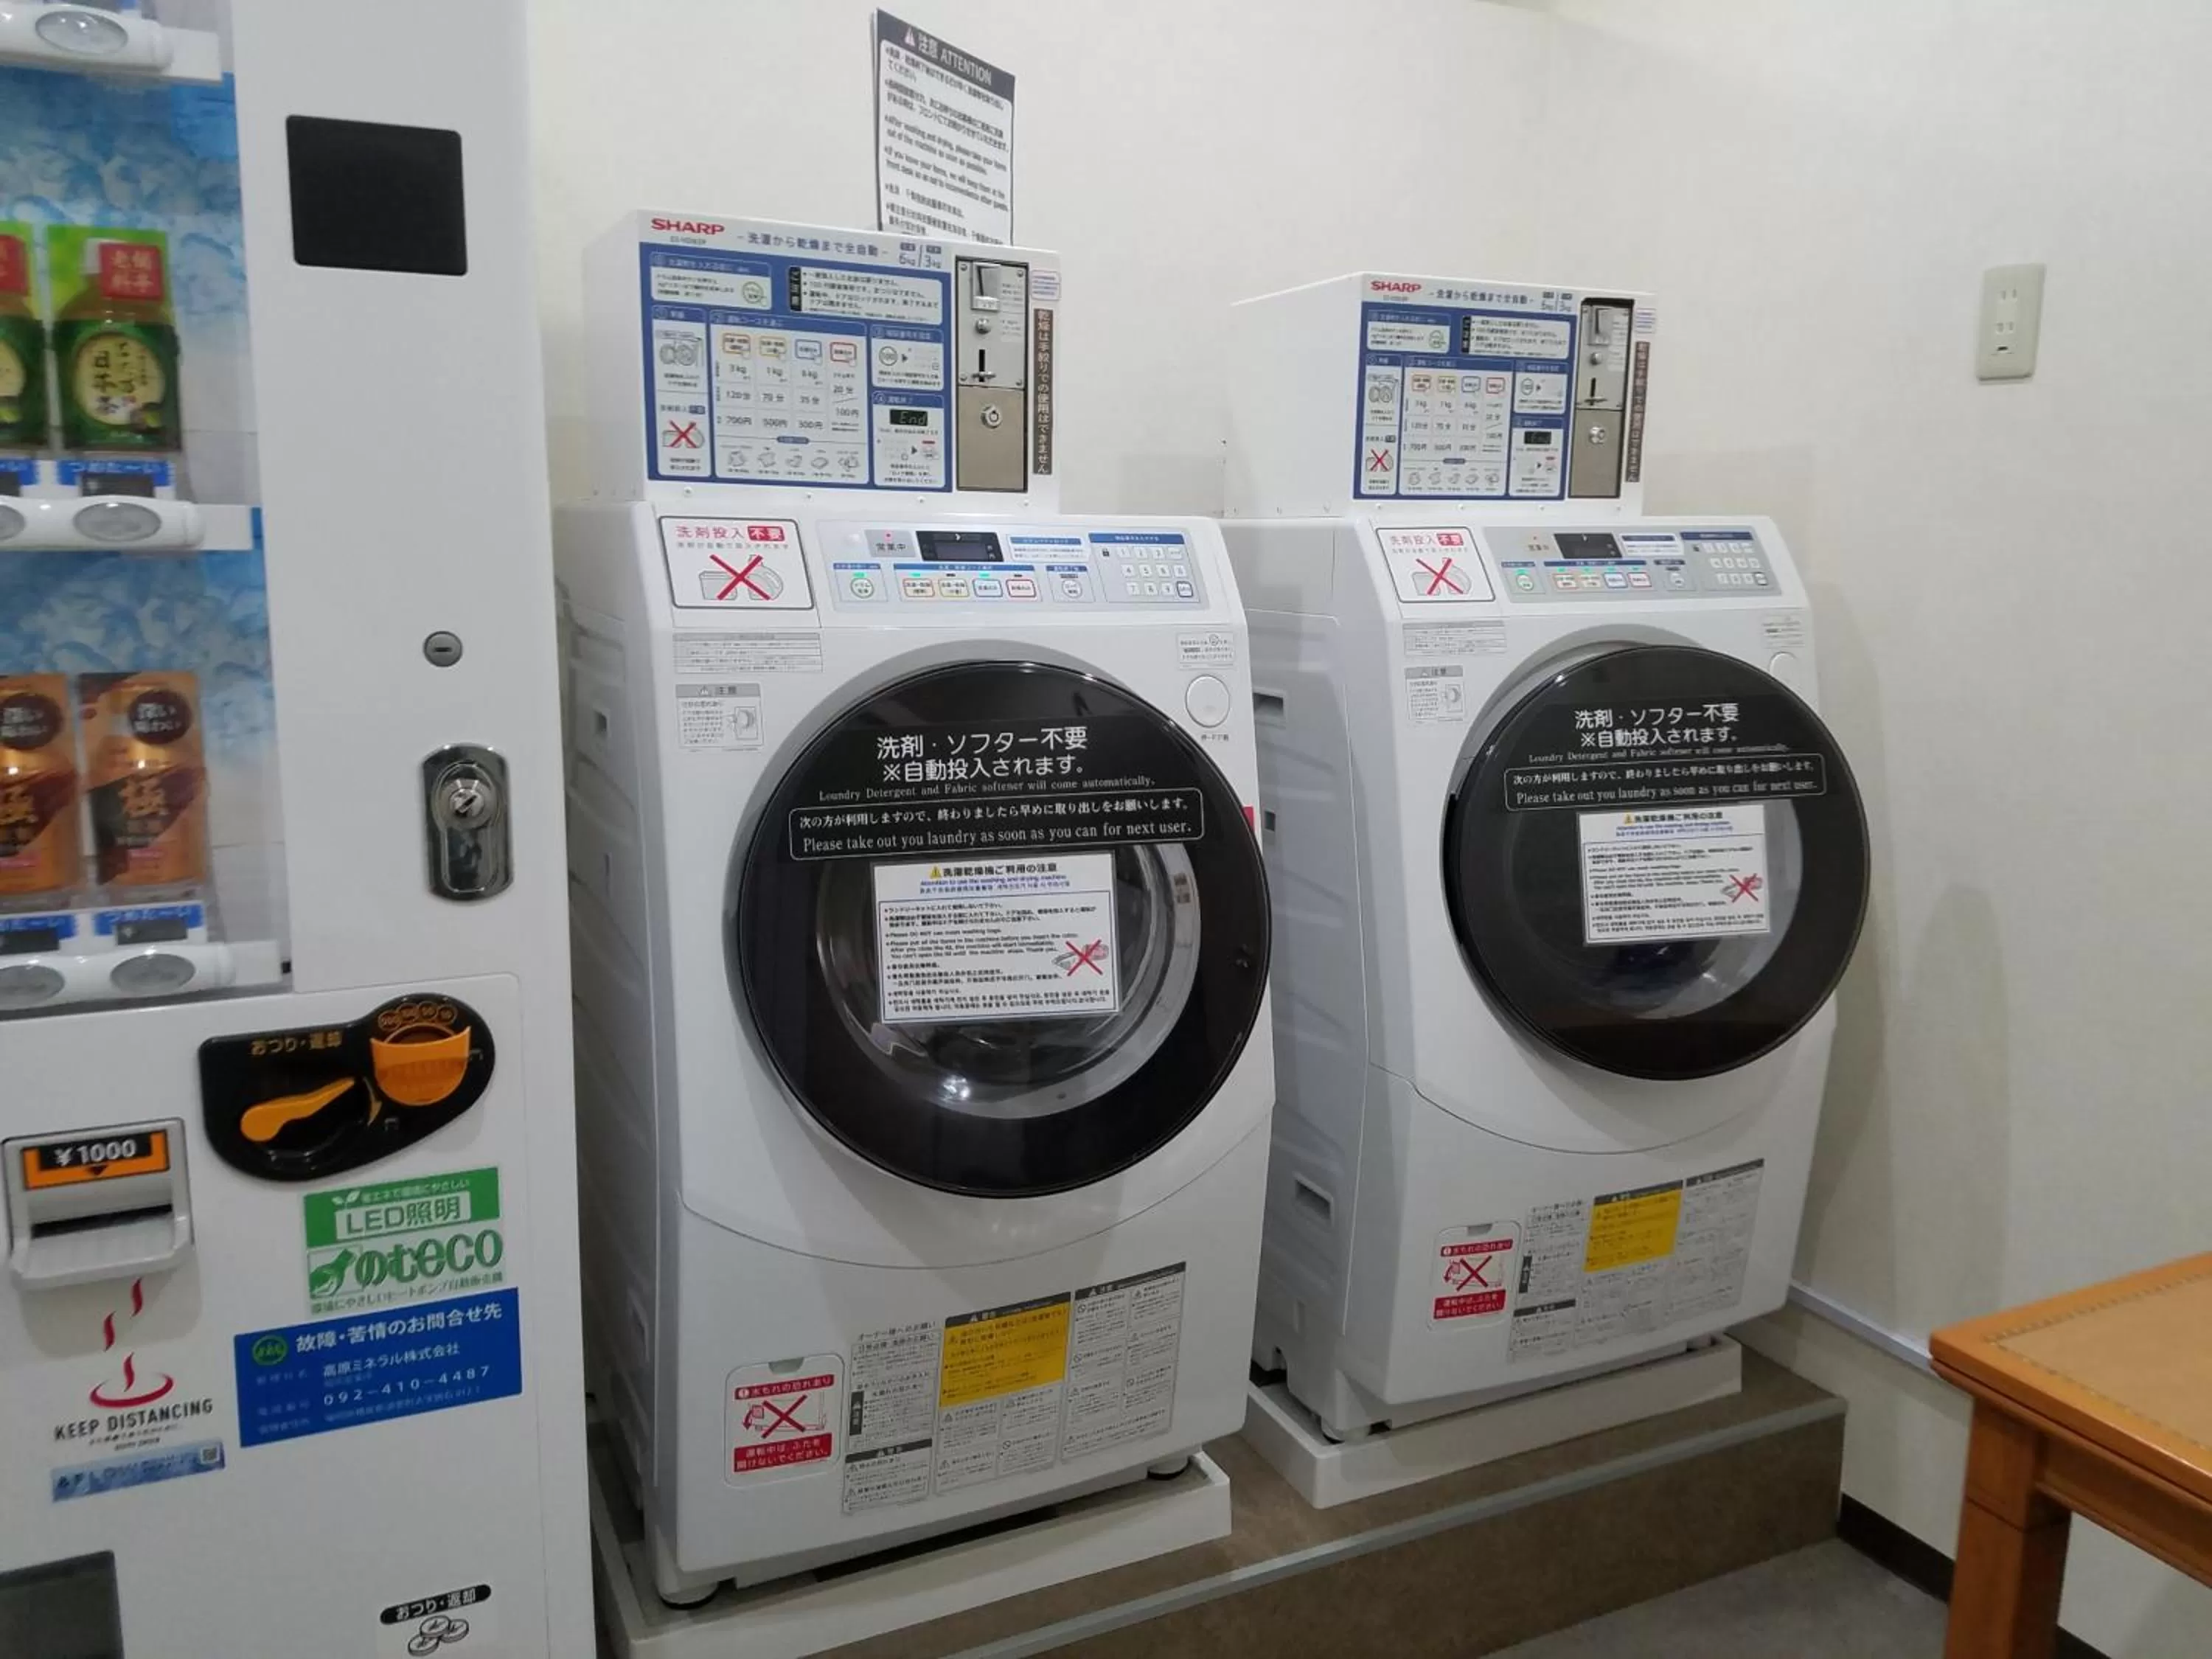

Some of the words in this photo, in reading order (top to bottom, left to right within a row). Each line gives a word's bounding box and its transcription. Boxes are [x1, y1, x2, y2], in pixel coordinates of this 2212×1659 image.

[940, 48, 992, 86] ATTENTION
[651, 218, 725, 235] SHARP
[748, 232, 878, 257] 洗濯から乾燥まで全自動
[1371, 280, 1422, 293] SHARP
[900, 411, 927, 425] End
[1574, 703, 1740, 730] 洗剤・ソフター不要
[877, 727, 1088, 759] 洗剤・ソフター不要
[883, 754, 1084, 782] ※自動投入されます。
[866, 787, 916, 799] Detergent
[922, 785, 939, 796] and
[945, 782, 977, 794] Fabric
[981, 780, 1023, 793] softener
[1027, 779, 1046, 790] will
[1051, 781, 1078, 790] come
[1517, 791, 1548, 804] Please
[1552, 790, 1575, 802] take
[1577, 791, 1594, 801] out
[1597, 790, 1615, 802] you
[1618, 786, 1656, 800] laundry
[1660, 788, 1672, 797] as
[1673, 787, 1695, 796] soon
[1698, 786, 1710, 795] as
[1713, 785, 1730, 796] you
[1753, 780, 1767, 791] for
[1770, 781, 1791, 790] next
[803, 837, 843, 852] Please
[847, 835, 874, 849] take
[877, 835, 897, 847] out
[902, 835, 924, 849] you
[928, 830, 976, 846] laundry
[980, 831, 995, 842] as
[998, 830, 1026, 842] soon
[1031, 828, 1045, 839] as
[1049, 828, 1071, 841] you
[1076, 826, 1097, 838] can
[1103, 823, 1122, 836] for
[1127, 823, 1155, 835] next
[1159, 821, 1192, 834] user.
[251, 1031, 342, 1055] おつり・返却
[346, 1196, 460, 1235] LED照明
[296, 1302, 503, 1353] 故障・苦情のお問合せ先
[322, 1340, 461, 1377] 高原ミネラル株式会社
[54, 1418, 100, 1441] KEEP
[108, 1398, 214, 1433] DISTANCING
[396, 1587, 476, 1621] おつり・返却
